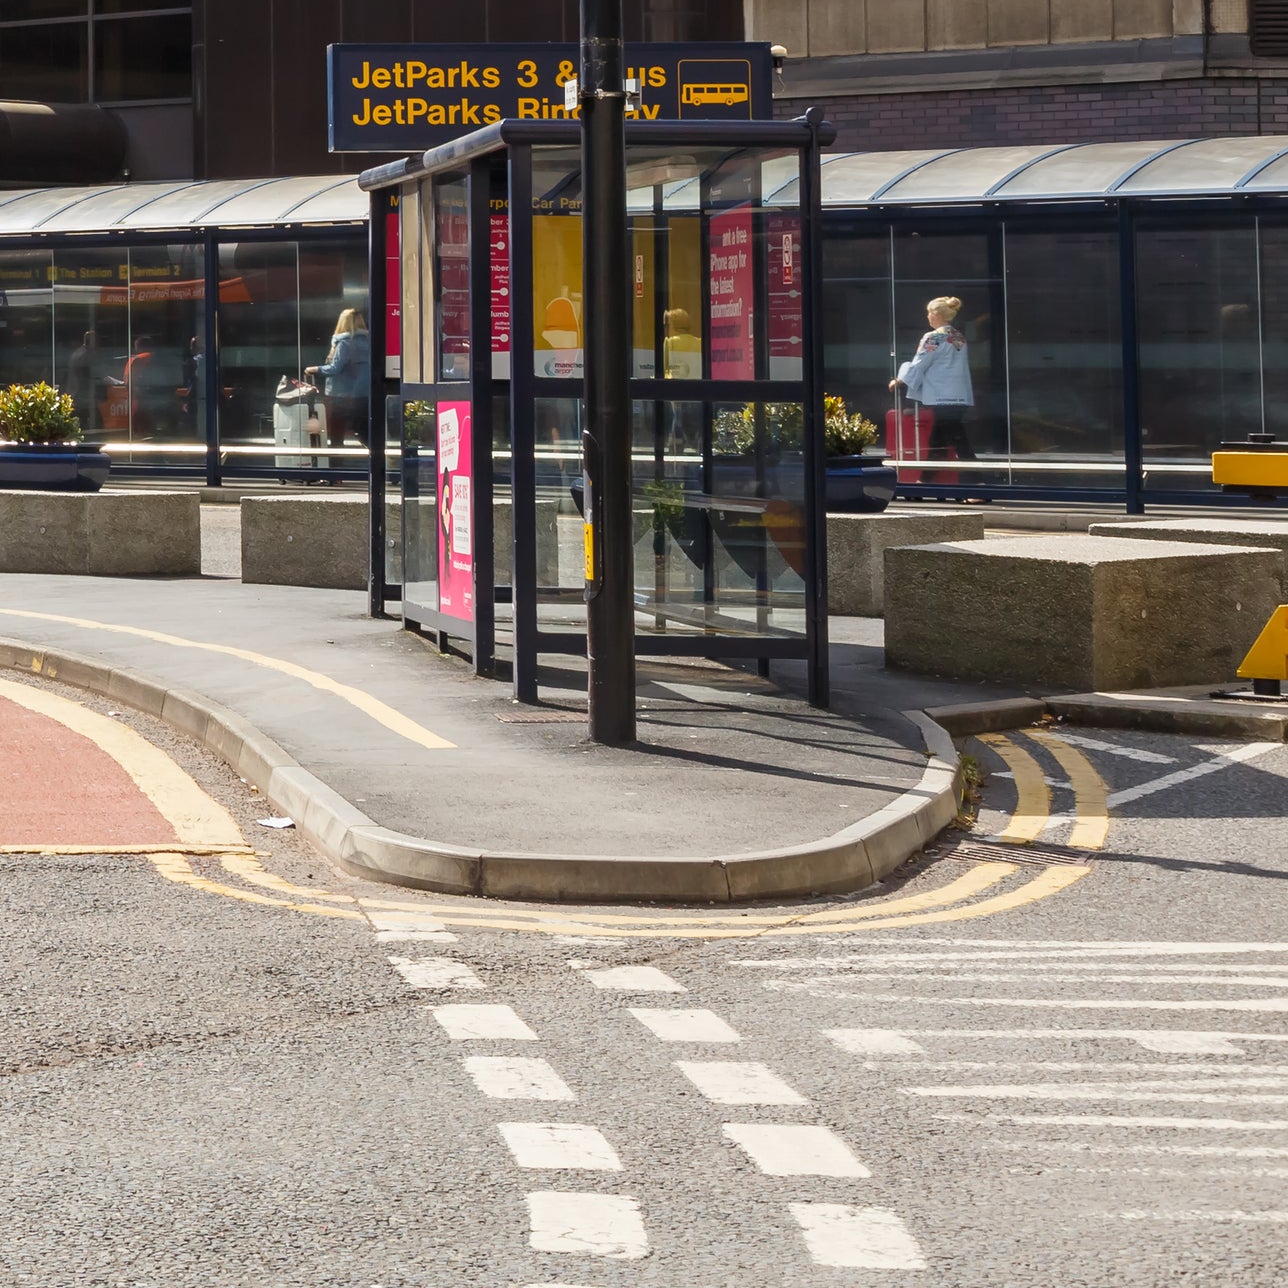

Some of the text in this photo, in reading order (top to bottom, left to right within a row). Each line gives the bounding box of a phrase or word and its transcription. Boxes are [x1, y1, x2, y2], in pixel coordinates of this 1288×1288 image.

[352, 60, 501, 90] JetParks
[517, 59, 539, 89] 3
[555, 59, 578, 88] &
[352, 97, 501, 126] JetParks
[532, 197, 554, 210] Car
[80, 267, 112, 278] Station
[174, 265, 180, 276] 2
